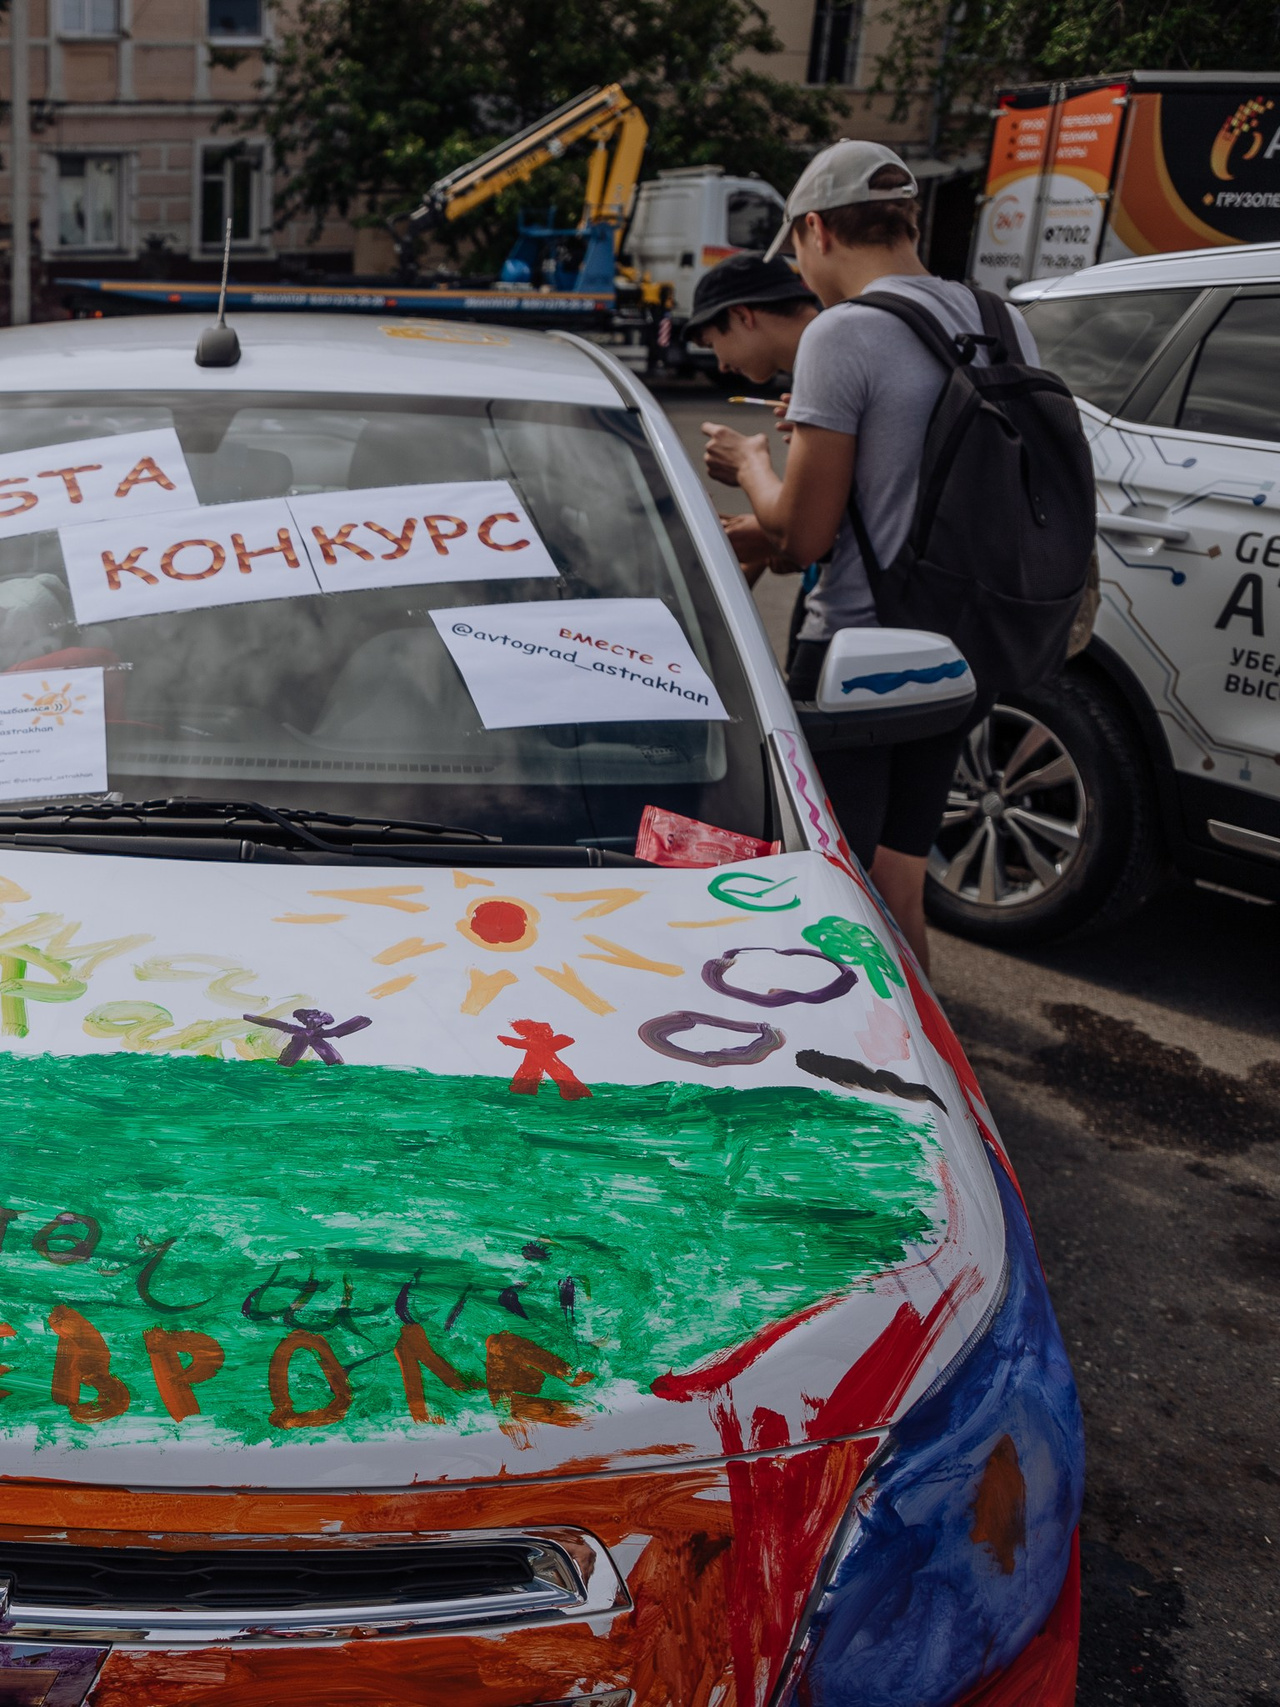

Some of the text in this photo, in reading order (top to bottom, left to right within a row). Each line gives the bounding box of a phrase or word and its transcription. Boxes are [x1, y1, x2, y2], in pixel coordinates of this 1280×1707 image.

[99, 511, 532, 592] КОНКУРС
[1214, 571, 1280, 637] A
[451, 622, 710, 706] @avtograd_astrakhan
[1229, 646, 1280, 677] УБЕ
